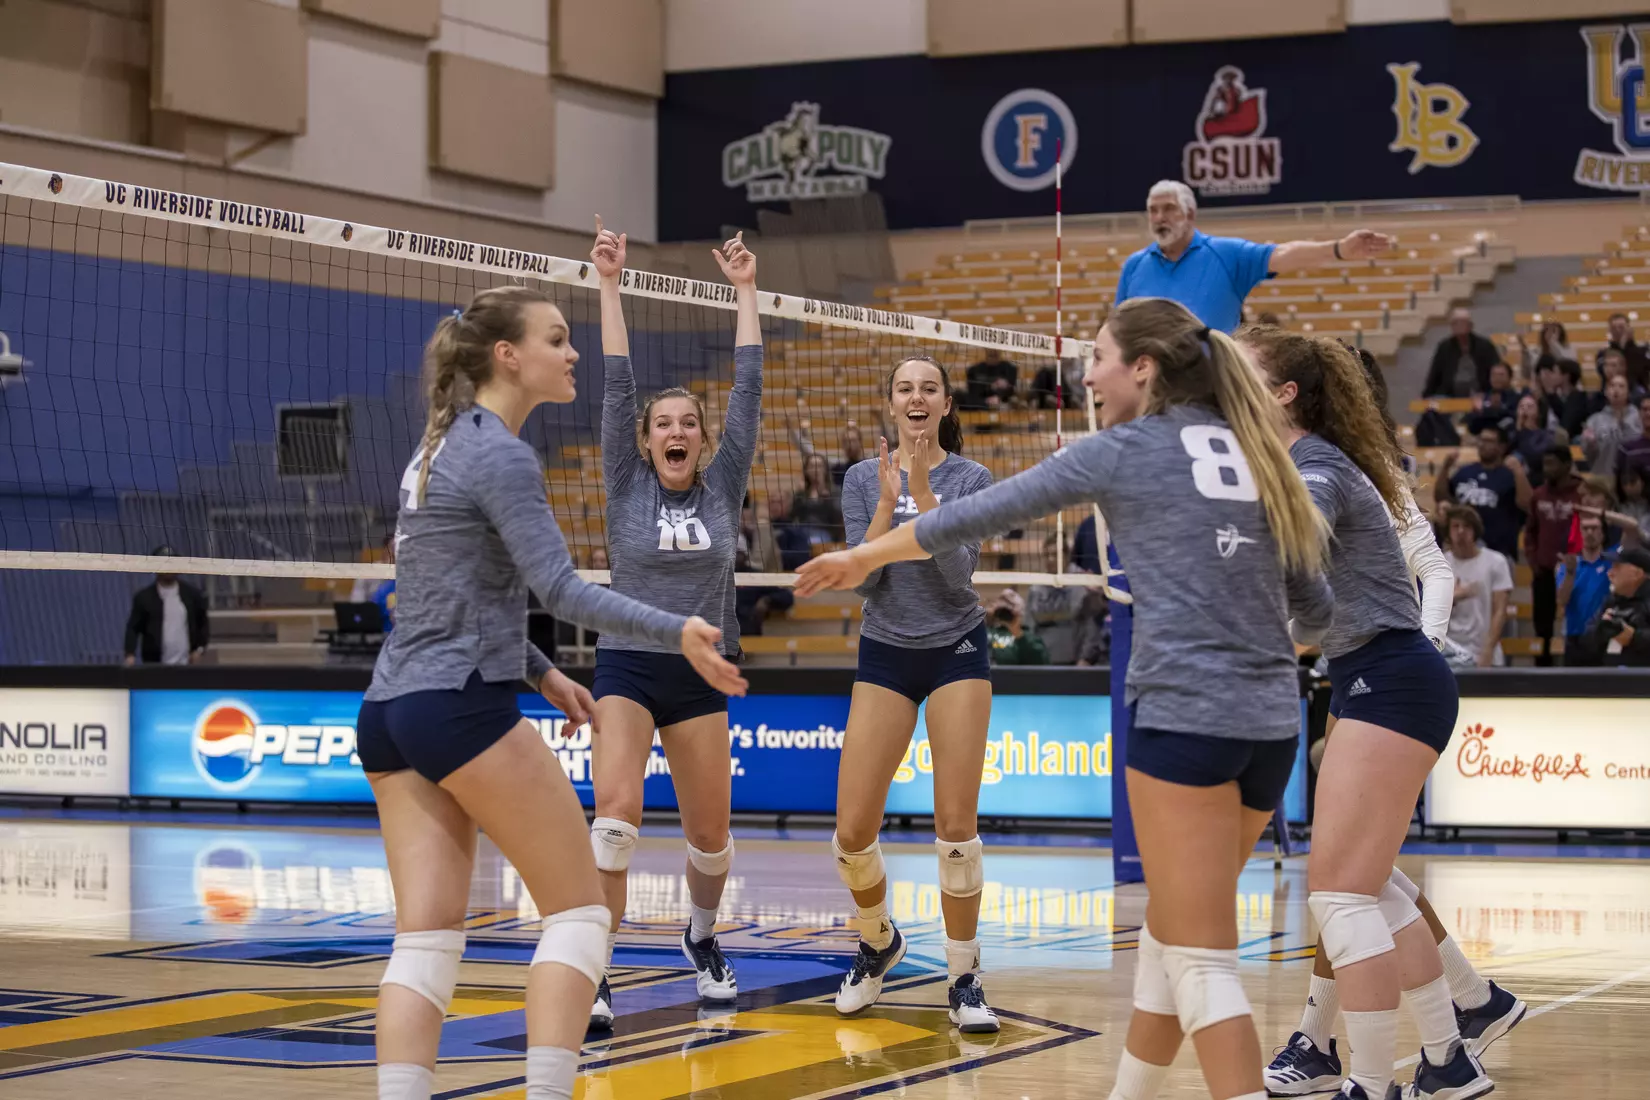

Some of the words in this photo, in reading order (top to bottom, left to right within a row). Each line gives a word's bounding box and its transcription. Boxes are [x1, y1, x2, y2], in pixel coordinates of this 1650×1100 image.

[727, 135, 778, 181] CAL
[817, 129, 885, 173] POLY
[1014, 113, 1048, 168] F
[1188, 142, 1275, 180] CSUN
[105, 181, 127, 205] UC
[133, 186, 214, 219] RIVERSIDE
[219, 200, 306, 234] VOLLEYBALL
[387, 229, 405, 250] UC
[409, 233, 475, 262] RIVERSIDE
[480, 245, 549, 274] VOLLEYBALL
[633, 271, 688, 296] RIVERSIDE
[804, 299, 817, 313] UC
[820, 300, 864, 322] RIVERSIDE
[867, 308, 914, 330] VOLLEYBALL
[959, 324, 969, 338] UC
[972, 327, 1009, 345] RIVERSIDE
[1179, 424, 1260, 502] 8
[657, 517, 712, 551] 10
[955, 646, 977, 655] adidas
[0, 722, 107, 750] NOLIA
[527, 718, 592, 750] UD
[1457, 736, 1591, 783] Chick-fil-A
